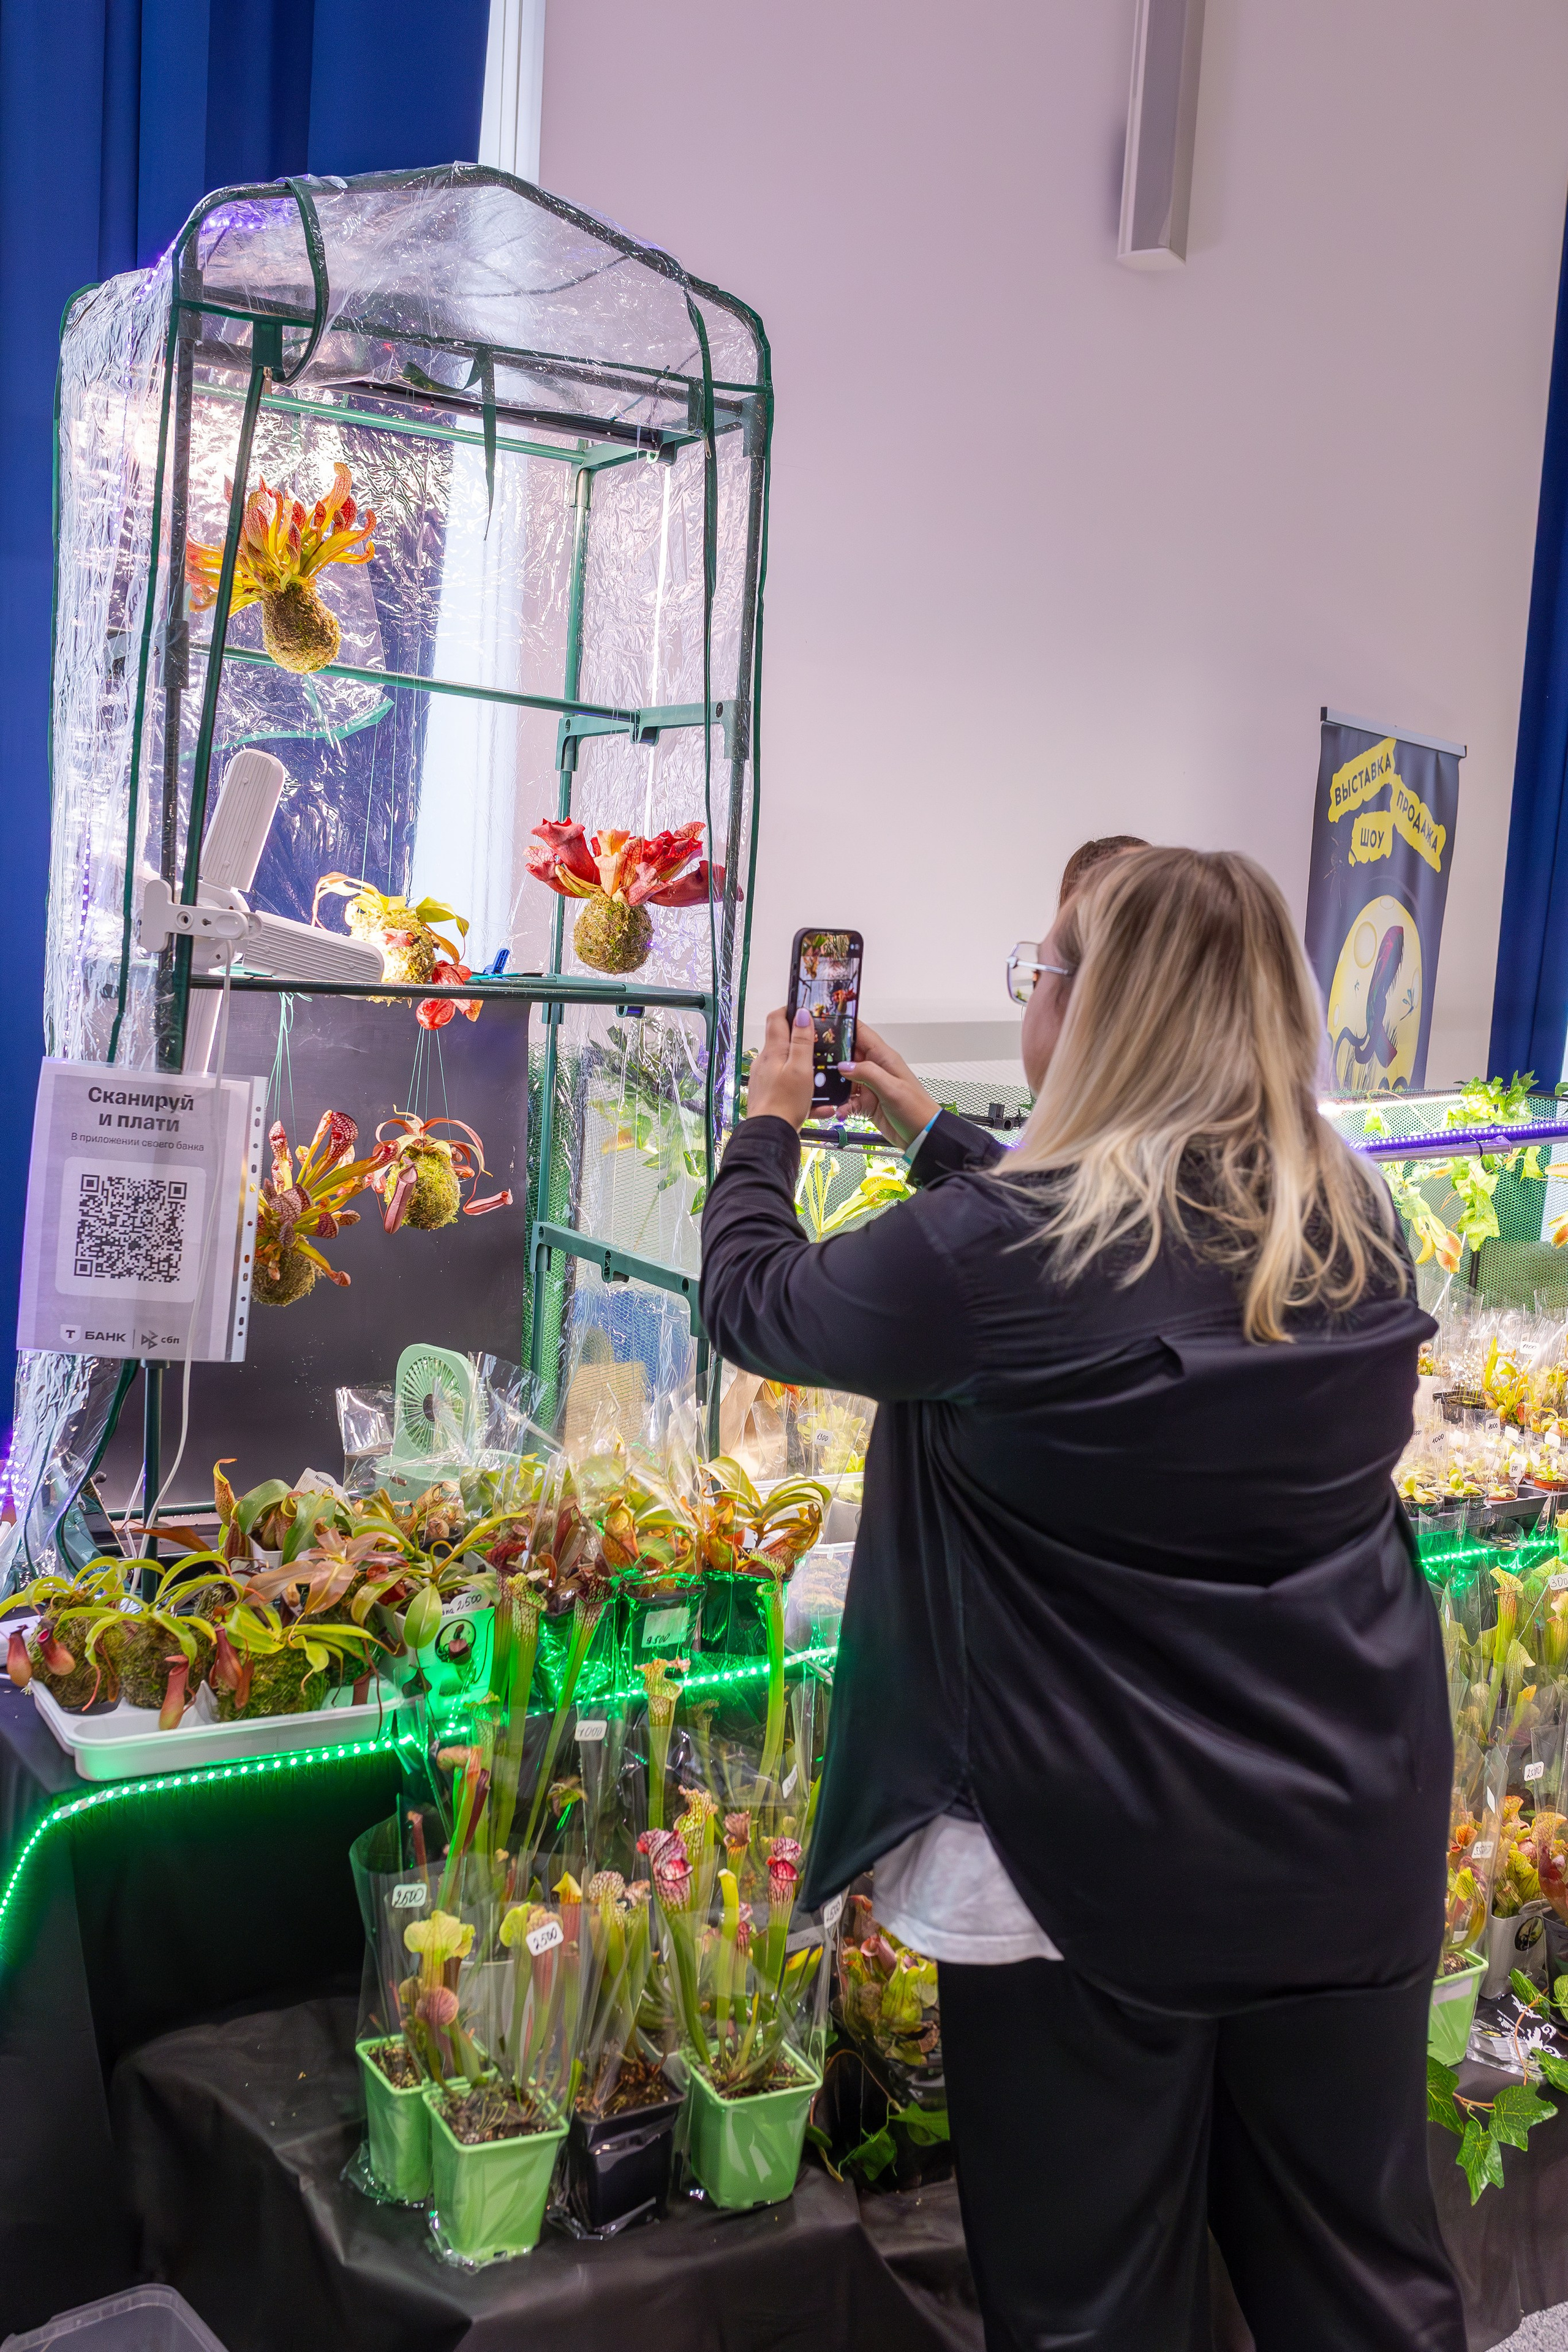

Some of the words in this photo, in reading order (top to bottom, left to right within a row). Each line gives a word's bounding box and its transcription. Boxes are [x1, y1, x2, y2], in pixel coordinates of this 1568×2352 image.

[1335, 752, 1392, 807] ВЫСТАВКА
[1396, 790, 1438, 853] ПРОДАЖА
[1360, 827, 1384, 849] ШОУ
[88, 1087, 194, 1113] Сканируй
[99, 1113, 112, 1126] и
[117, 1115, 179, 1133] плати
[71, 1132, 78, 1140] В
[80, 1134, 140, 1145] приложении
[141, 1139, 174, 1149] своего
[176, 1140, 205, 1152] банка
[85, 1330, 127, 1343] БАНК
[160, 1336, 180, 1344] сбп
[1431, 1433, 1444, 1444] 1000
[533, 1927, 557, 1950] 2500
